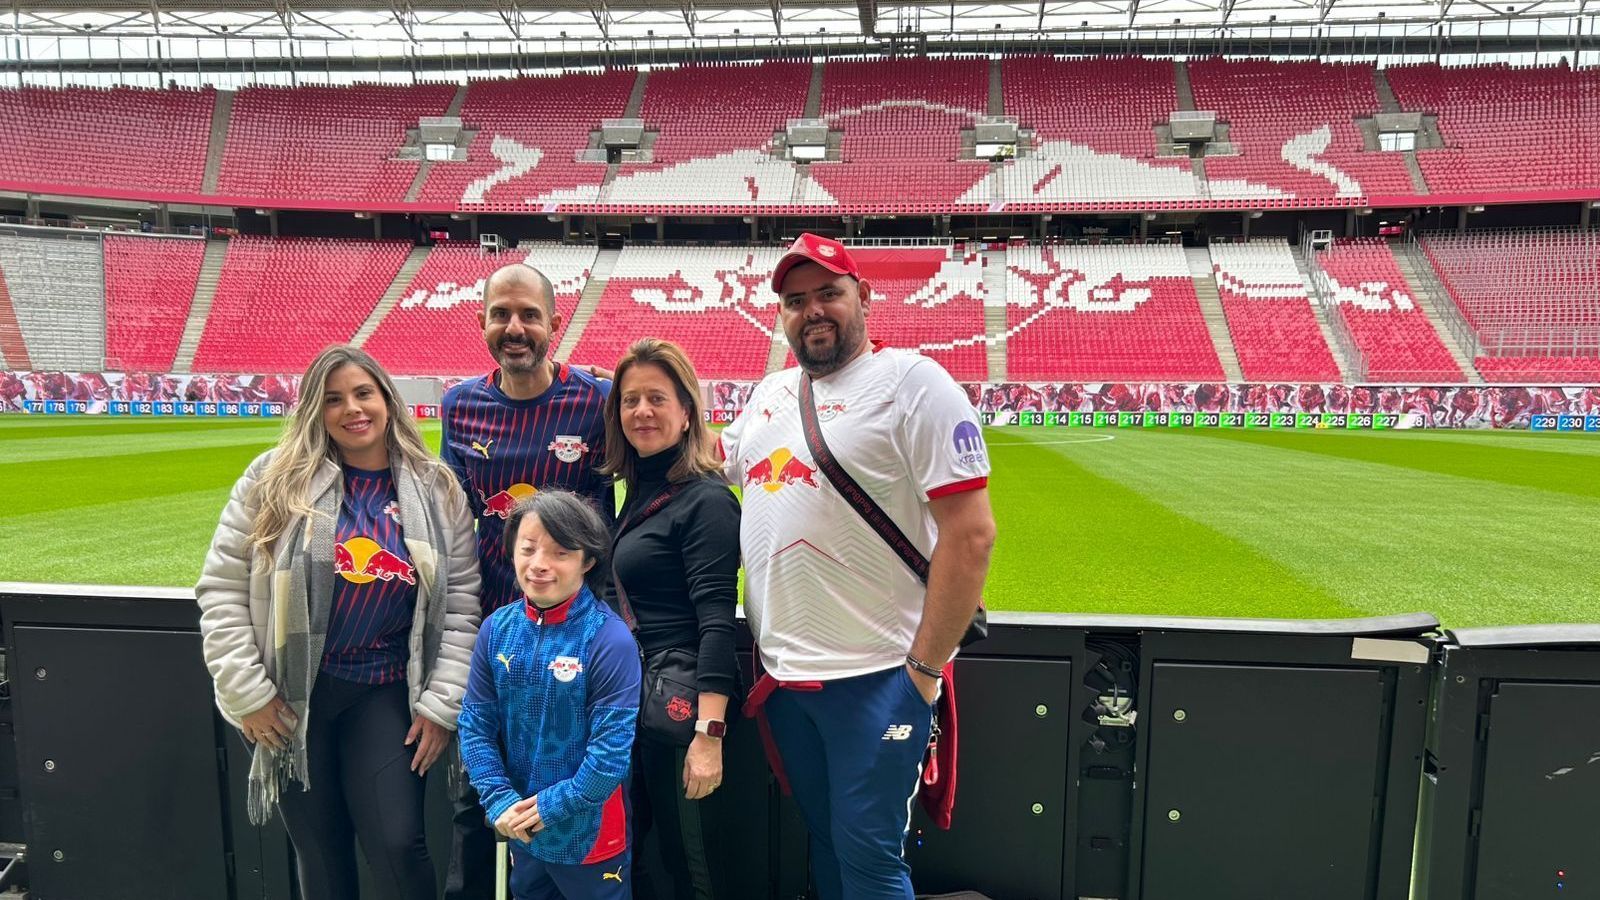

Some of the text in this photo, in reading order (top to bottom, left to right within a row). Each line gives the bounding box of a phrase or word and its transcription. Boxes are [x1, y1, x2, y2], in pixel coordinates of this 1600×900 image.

[49, 402, 65, 412] 178
[70, 402, 86, 412] 179
[114, 402, 129, 412] 181
[135, 403, 151, 413] 182
[156, 404, 173, 413] 183
[177, 404, 194, 413] 184
[199, 404, 216, 413] 185
[221, 404, 238, 414] 186
[243, 404, 259, 414] 187
[265, 405, 281, 414] 188
[419, 407, 435, 416] 191
[715, 411, 734, 421] 204
[1023, 414, 1042, 424] 213
[1048, 414, 1067, 424] 214
[1073, 414, 1092, 424] 215
[1098, 414, 1117, 424] 216
[1122, 414, 1142, 424] 217
[1148, 414, 1167, 425] 218
[1173, 414, 1192, 425] 219
[1199, 414, 1218, 425] 220
[1224, 415, 1242, 425] 221
[1249, 415, 1268, 425] 222
[1275, 415, 1294, 426] 223
[1300, 415, 1319, 426] 224
[1326, 415, 1345, 426] 225
[1352, 415, 1371, 426] 226
[1377, 415, 1397, 426] 227
[1535, 417, 1556, 428] 229
[1561, 417, 1582, 428] 230
[881, 724, 912, 740] NB
